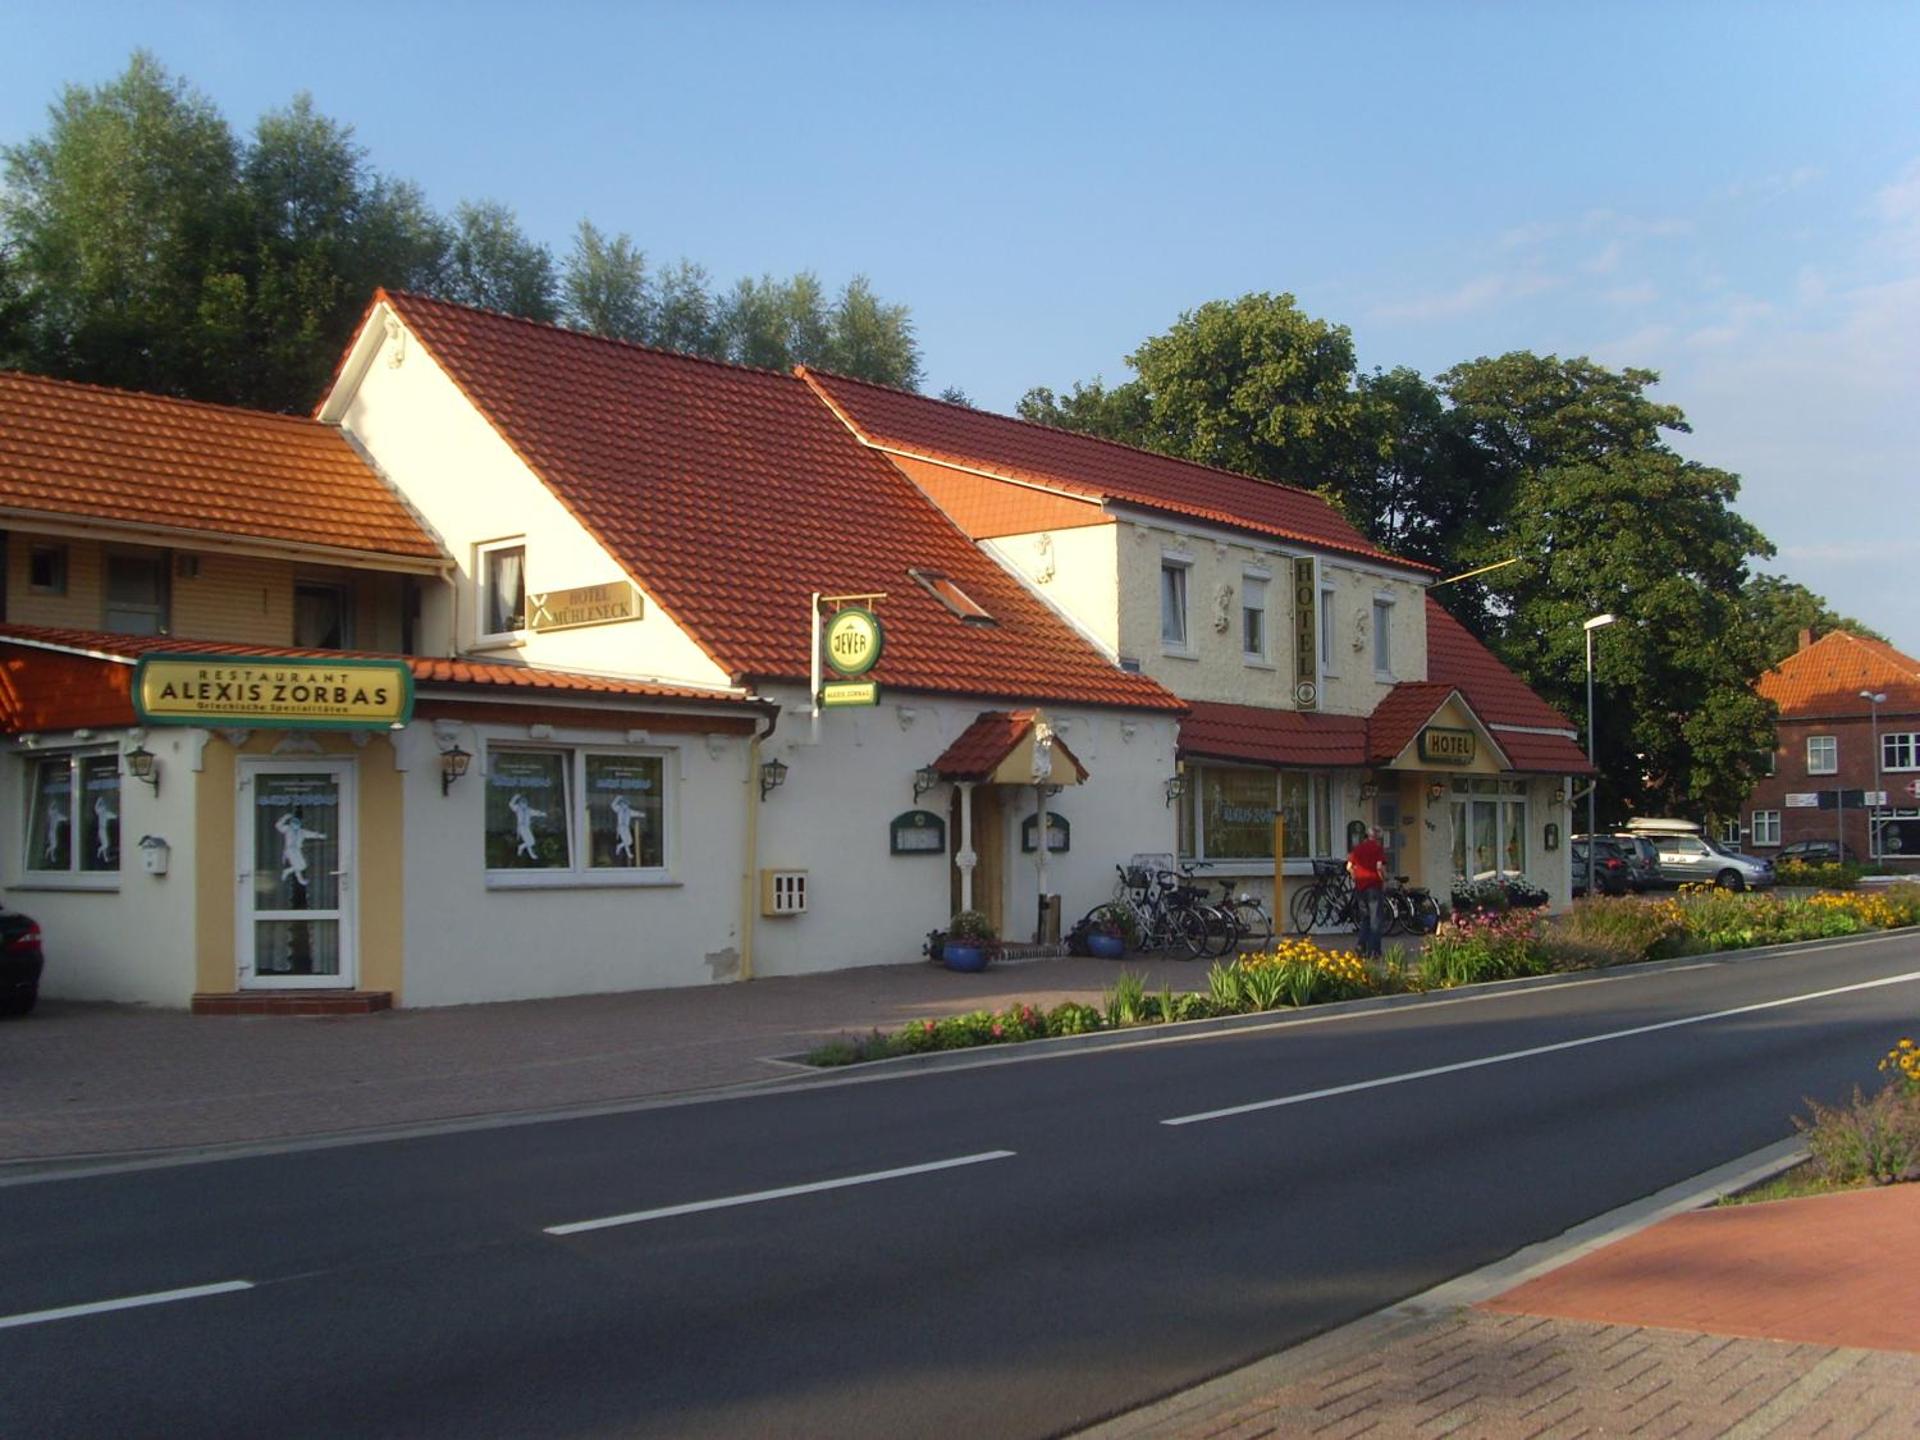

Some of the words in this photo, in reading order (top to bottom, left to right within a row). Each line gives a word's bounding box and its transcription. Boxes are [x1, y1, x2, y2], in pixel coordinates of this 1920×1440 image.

[569, 587, 609, 606] HOTEL
[553, 601, 630, 625] MÜHLENECK
[1298, 563, 1313, 676] HOTEL
[834, 632, 867, 655] JEVER
[199, 670, 350, 684] RESTAURANT
[160, 682, 261, 702] ALEXIS
[273, 684, 388, 705] ZORBAS
[196, 702, 265, 711] Griechische
[270, 703, 349, 714] Spezialitäten
[1431, 735, 1470, 754] HOTEL
